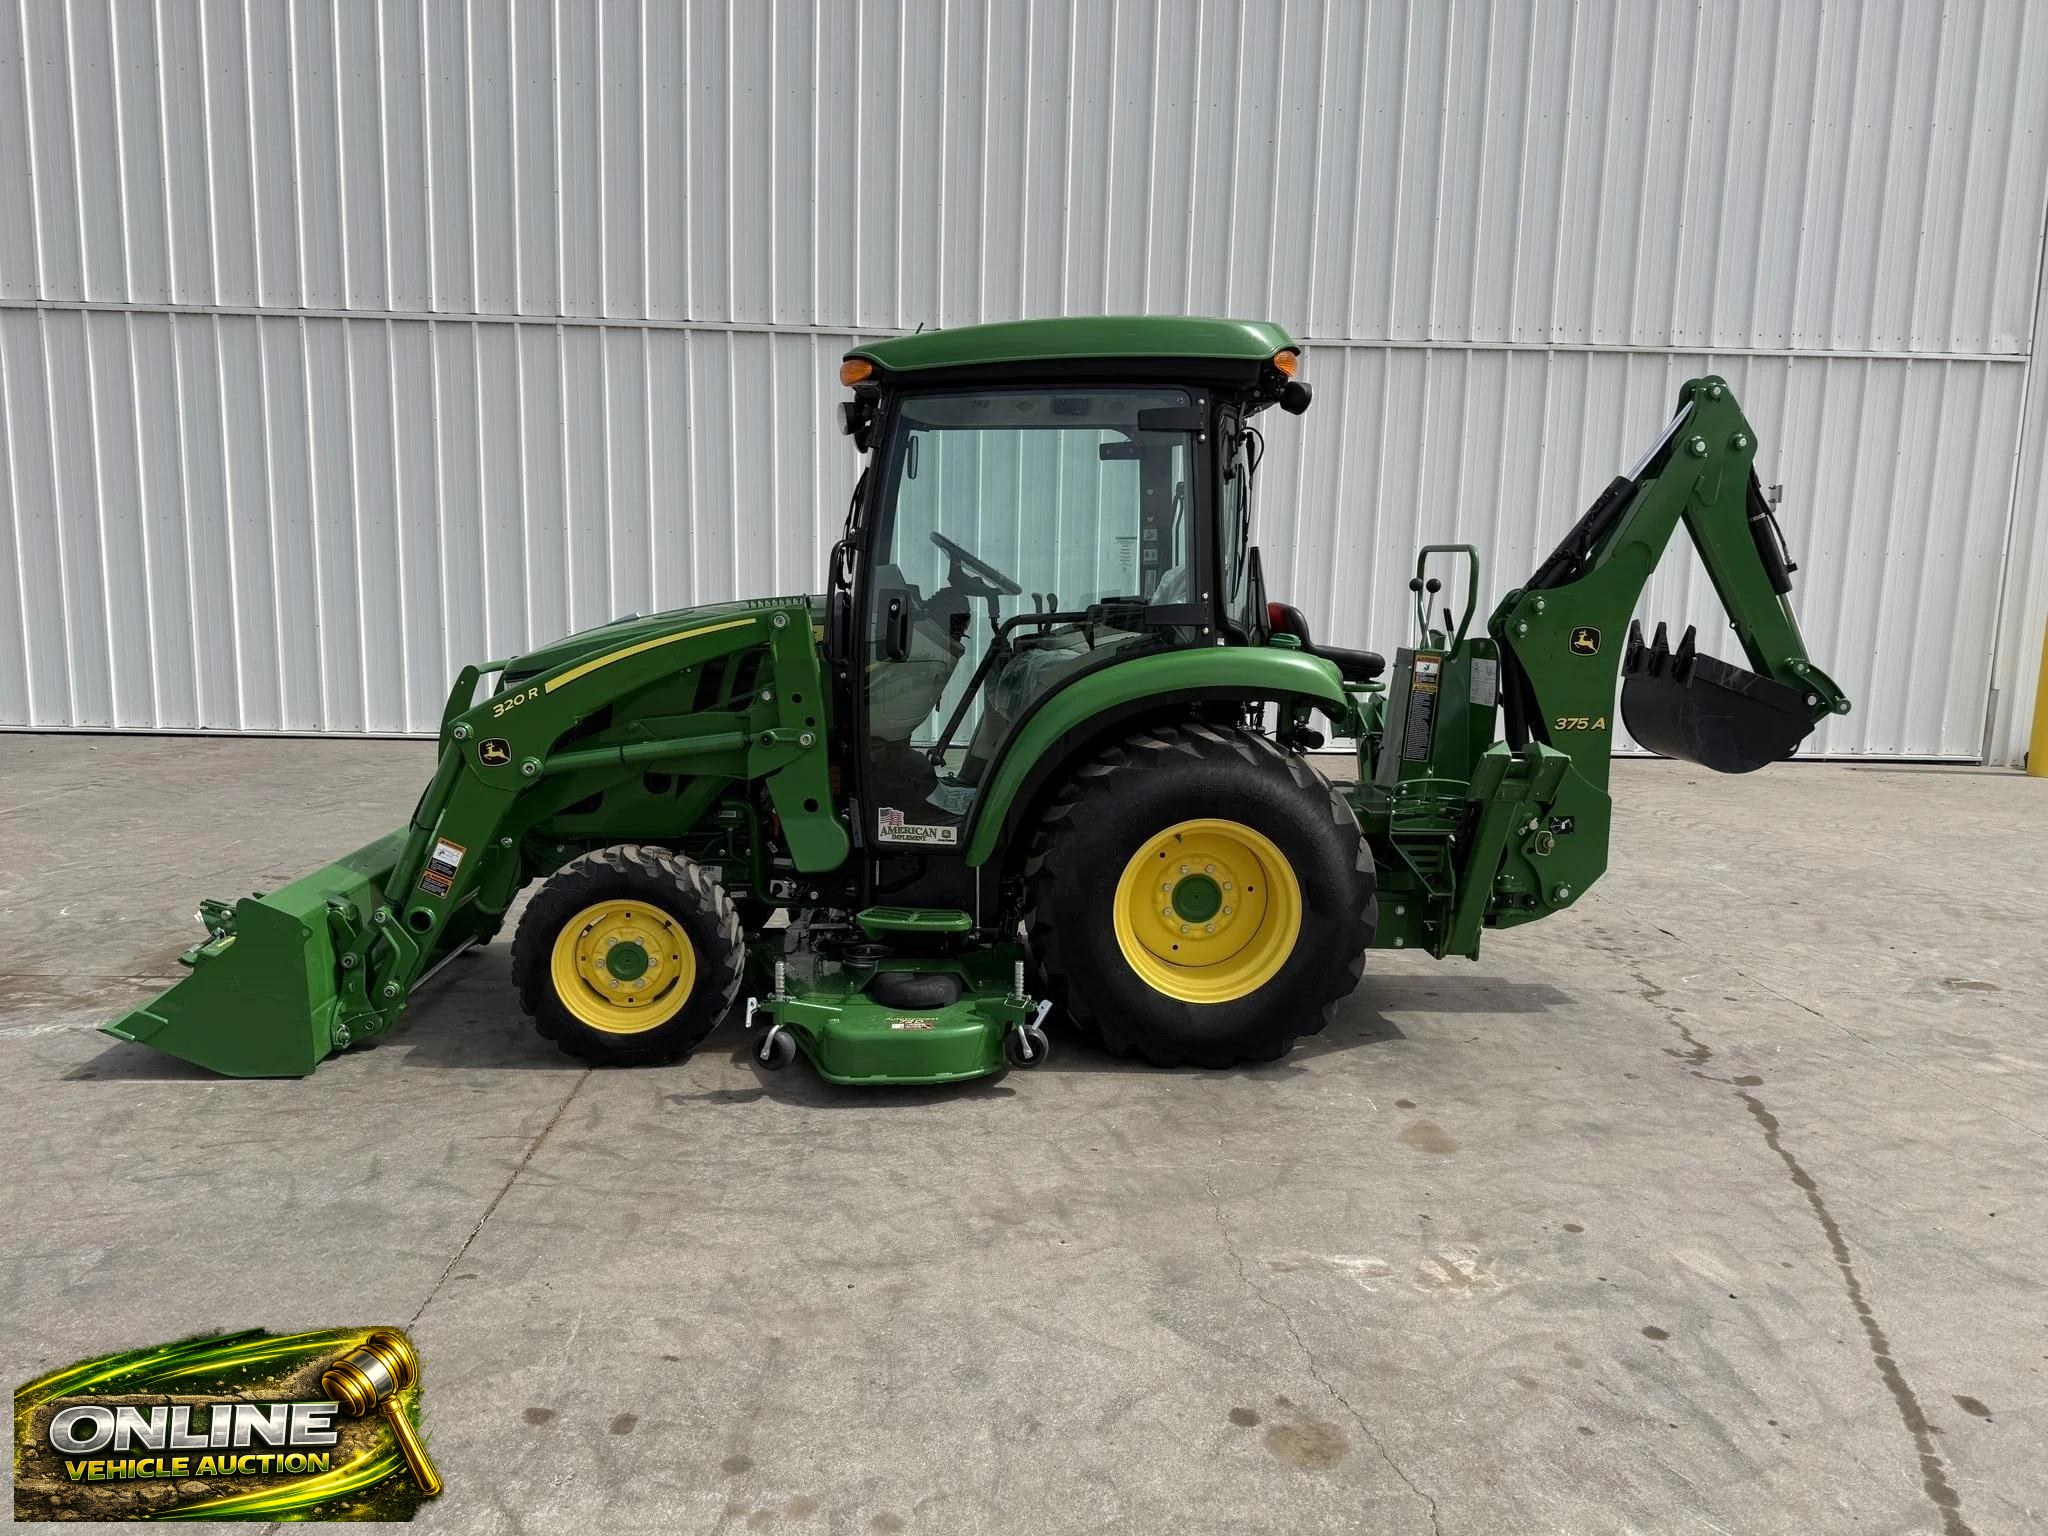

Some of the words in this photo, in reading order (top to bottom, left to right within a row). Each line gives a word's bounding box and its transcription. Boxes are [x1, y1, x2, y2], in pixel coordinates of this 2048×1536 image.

[493, 694, 525, 718] 320
[528, 687, 539, 700] R
[1554, 717, 1590, 730] 375
[1590, 717, 1606, 730] A
[880, 825, 938, 839] AMERICAN
